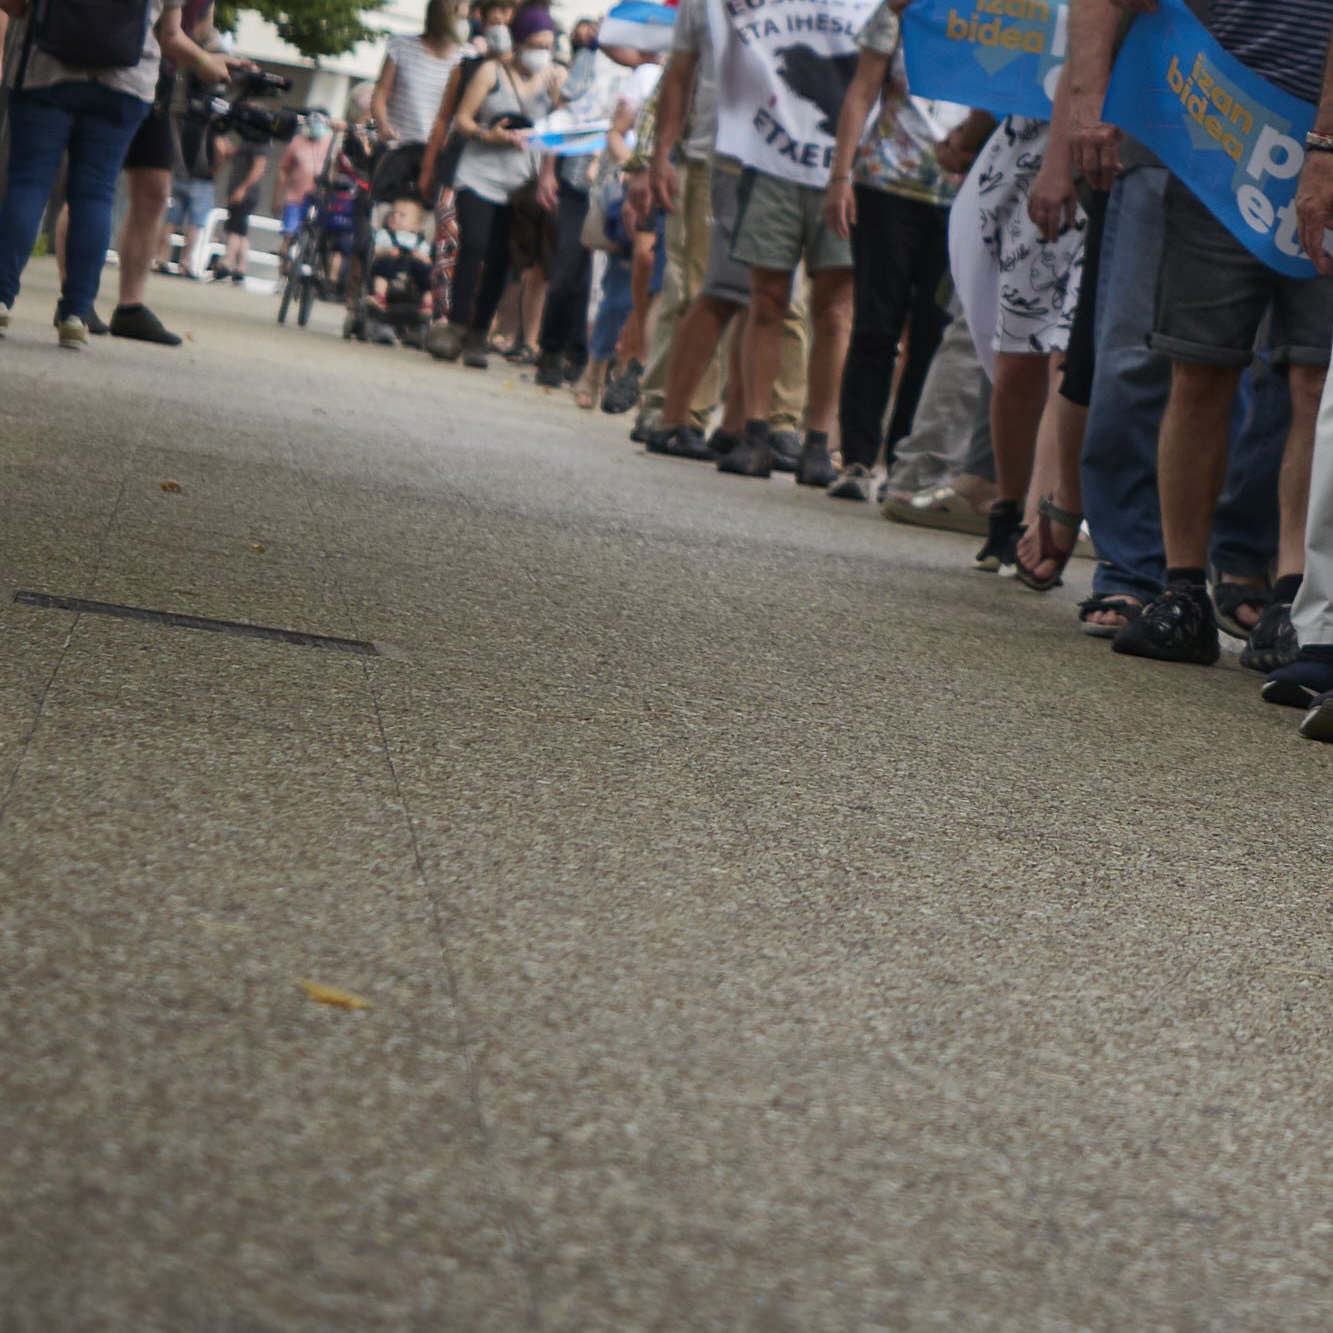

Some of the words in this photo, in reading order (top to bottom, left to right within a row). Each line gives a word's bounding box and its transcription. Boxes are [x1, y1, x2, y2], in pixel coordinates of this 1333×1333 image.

[945, 9, 1045, 53] bidea
[1166, 57, 1244, 162] bidea
[1193, 52, 1254, 136] izan
